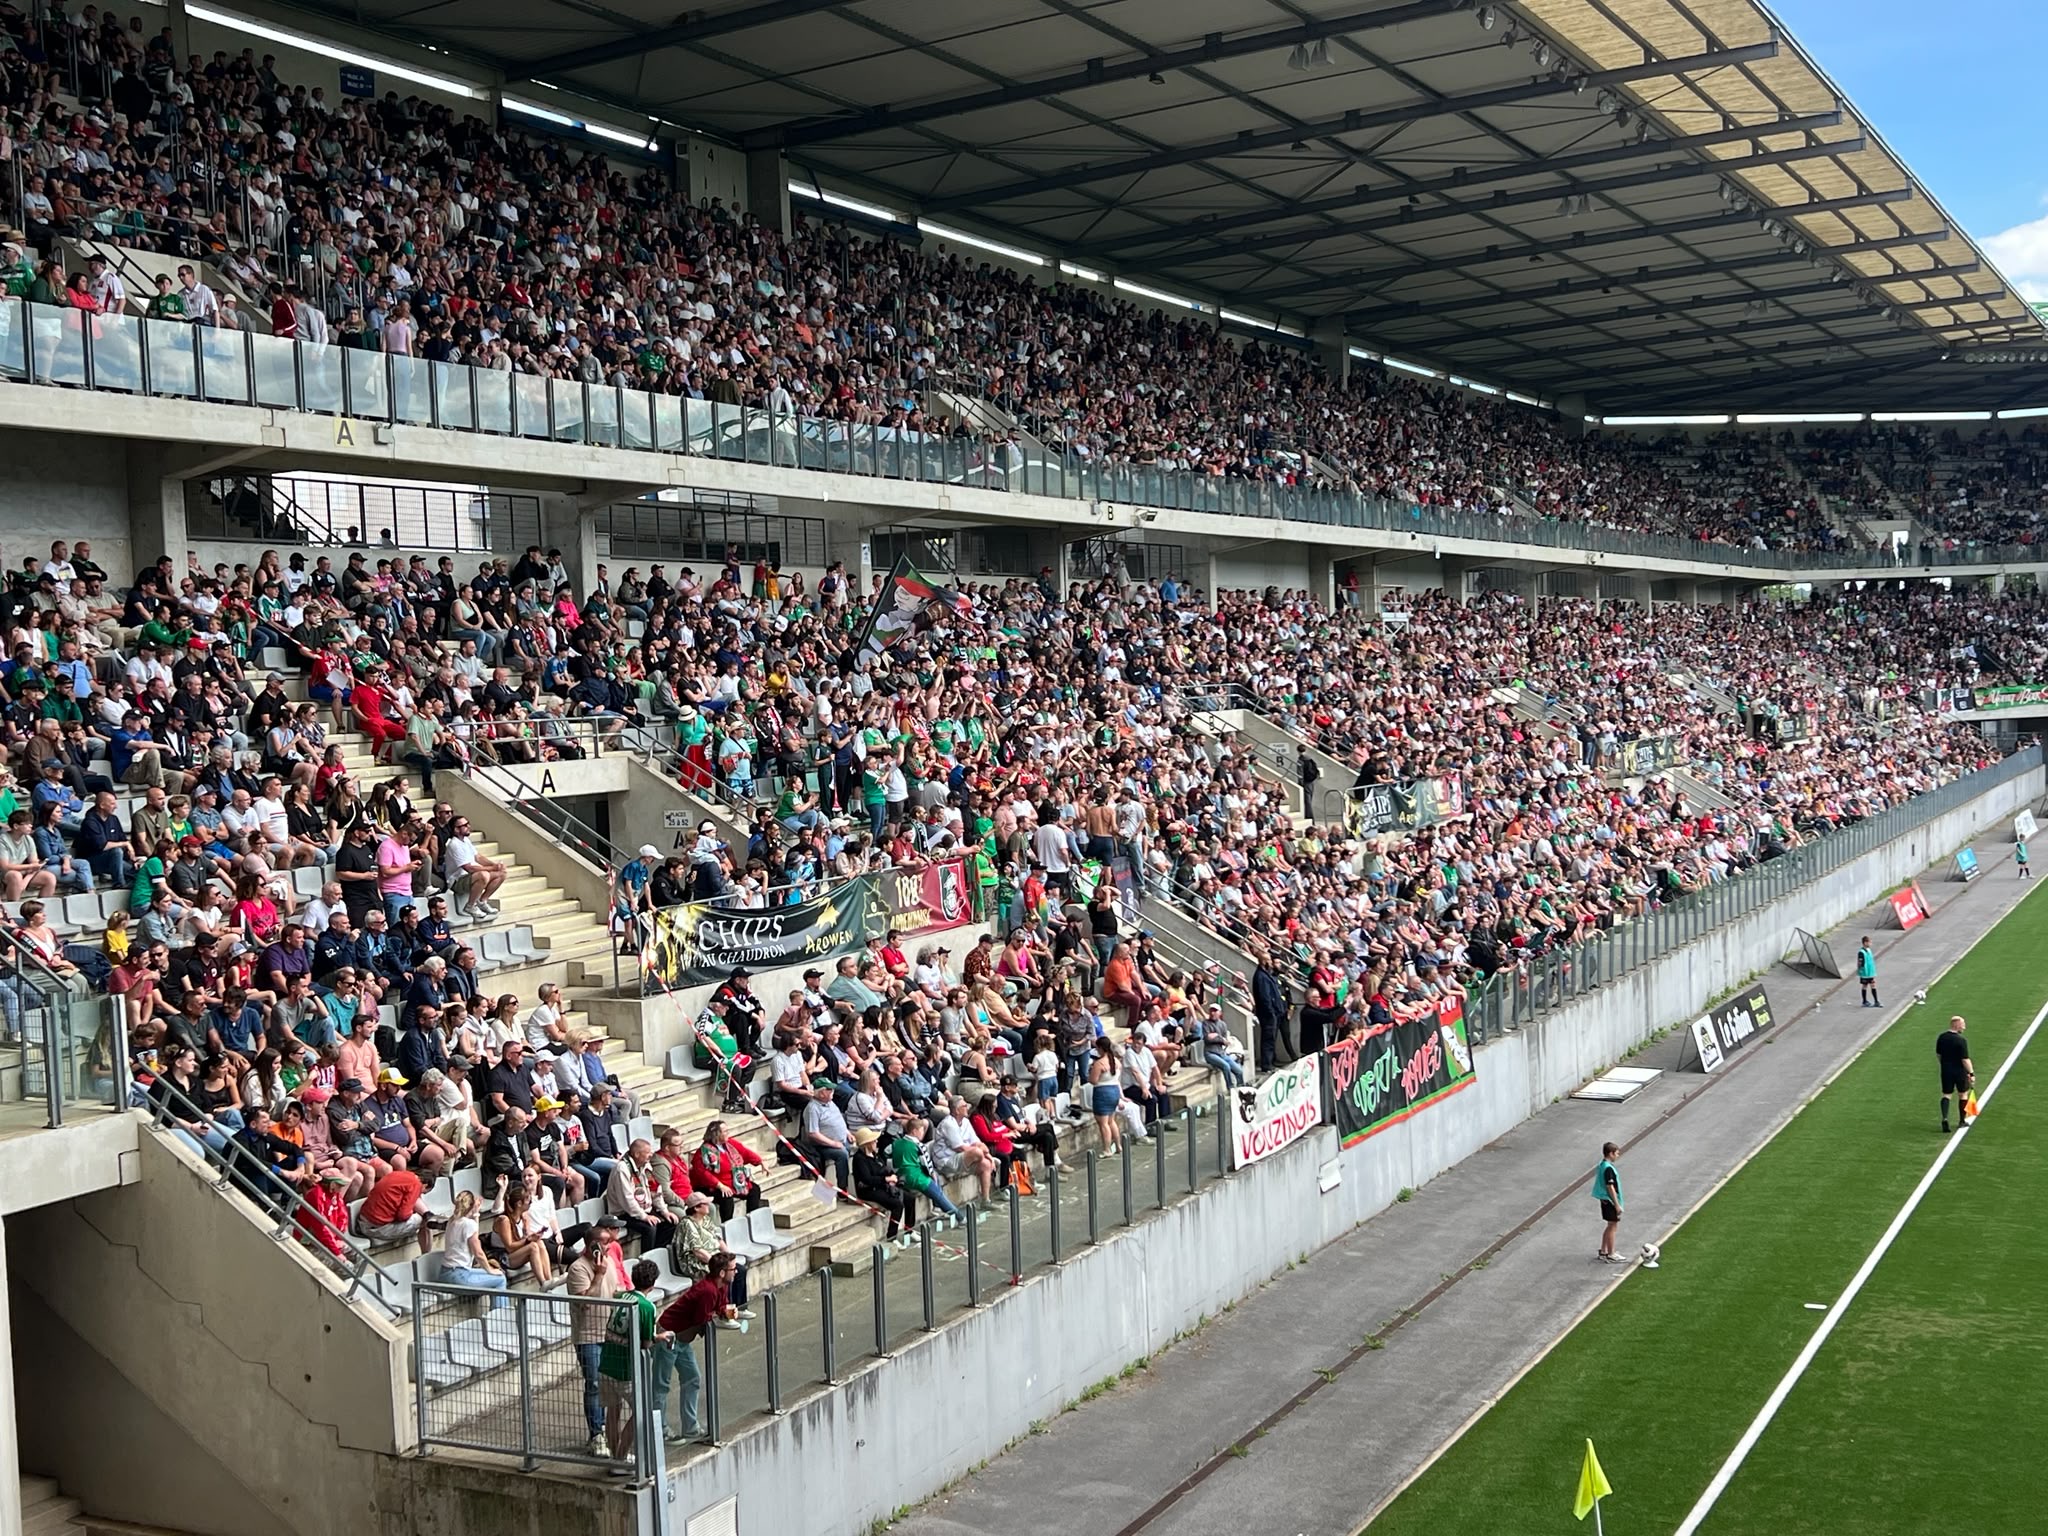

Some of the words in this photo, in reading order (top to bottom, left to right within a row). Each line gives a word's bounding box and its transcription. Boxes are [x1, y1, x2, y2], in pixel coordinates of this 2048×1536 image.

[336, 420, 354, 446] A
[1107, 505, 1114, 520] B
[541, 768, 556, 794] A
[699, 914, 785, 951] CHIPS
[701, 952, 717, 968] AU
[718, 943, 787, 968] CHAUDRON
[1267, 1075, 1298, 1111] KOP
[1353, 1047, 1391, 1116] VERT
[1241, 1099, 1317, 1160] VOUZINOIS
